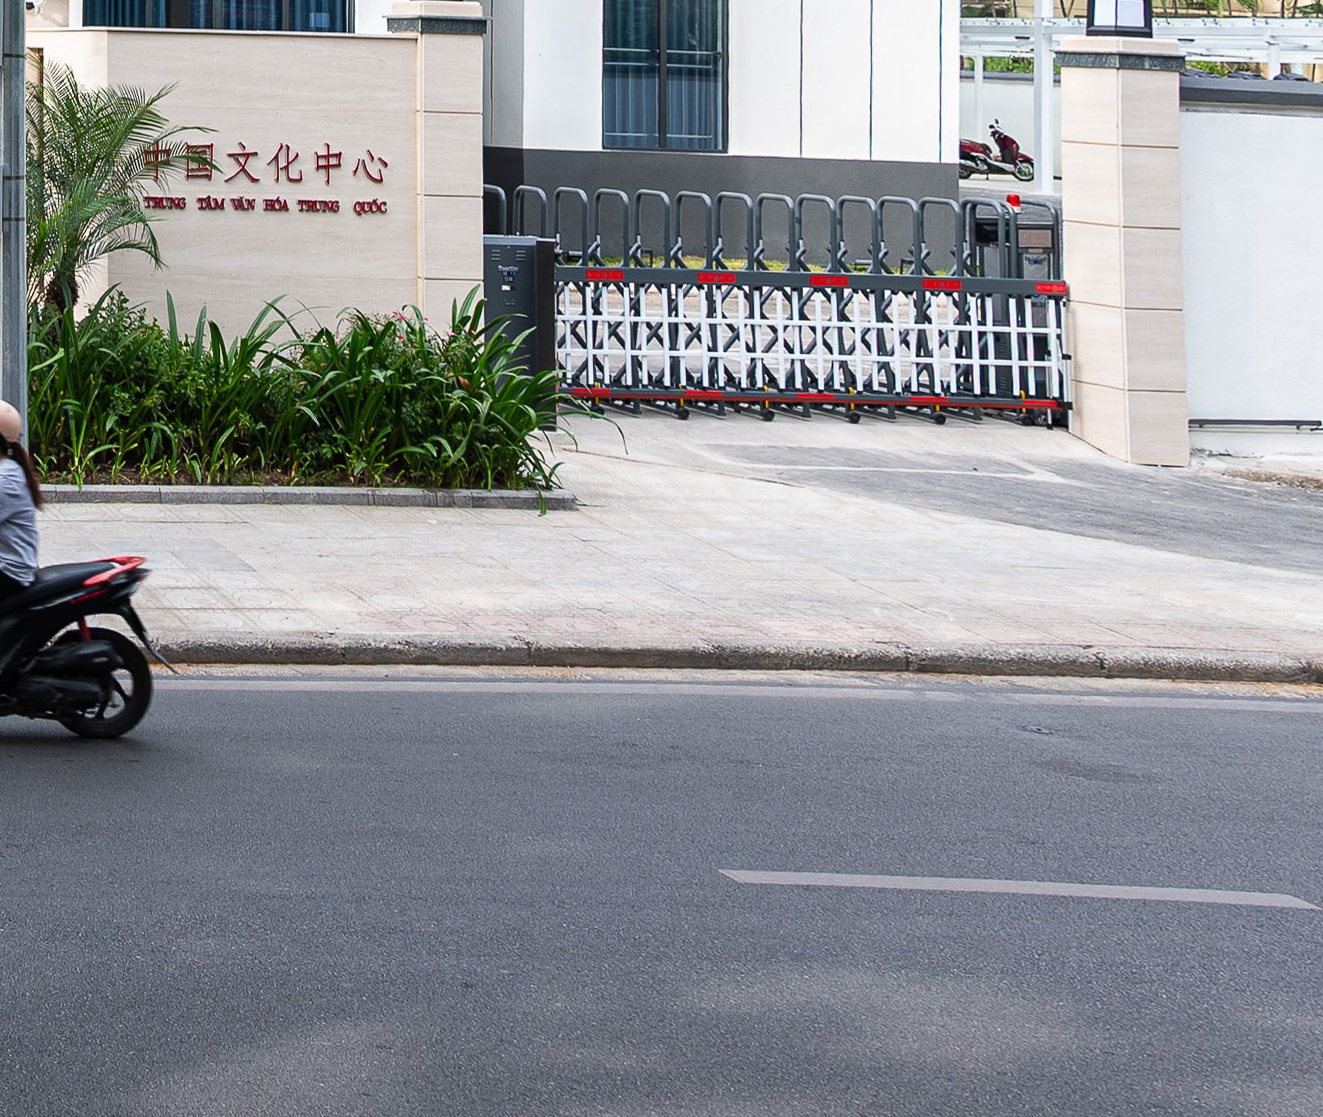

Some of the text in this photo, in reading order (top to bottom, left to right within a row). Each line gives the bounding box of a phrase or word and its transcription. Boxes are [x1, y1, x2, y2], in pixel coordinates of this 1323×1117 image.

[144, 141, 389, 186] 中国文化中心
[144, 195, 388, 216] TRUNG TÂM VĂN HÓA TRUNG QUỐC
